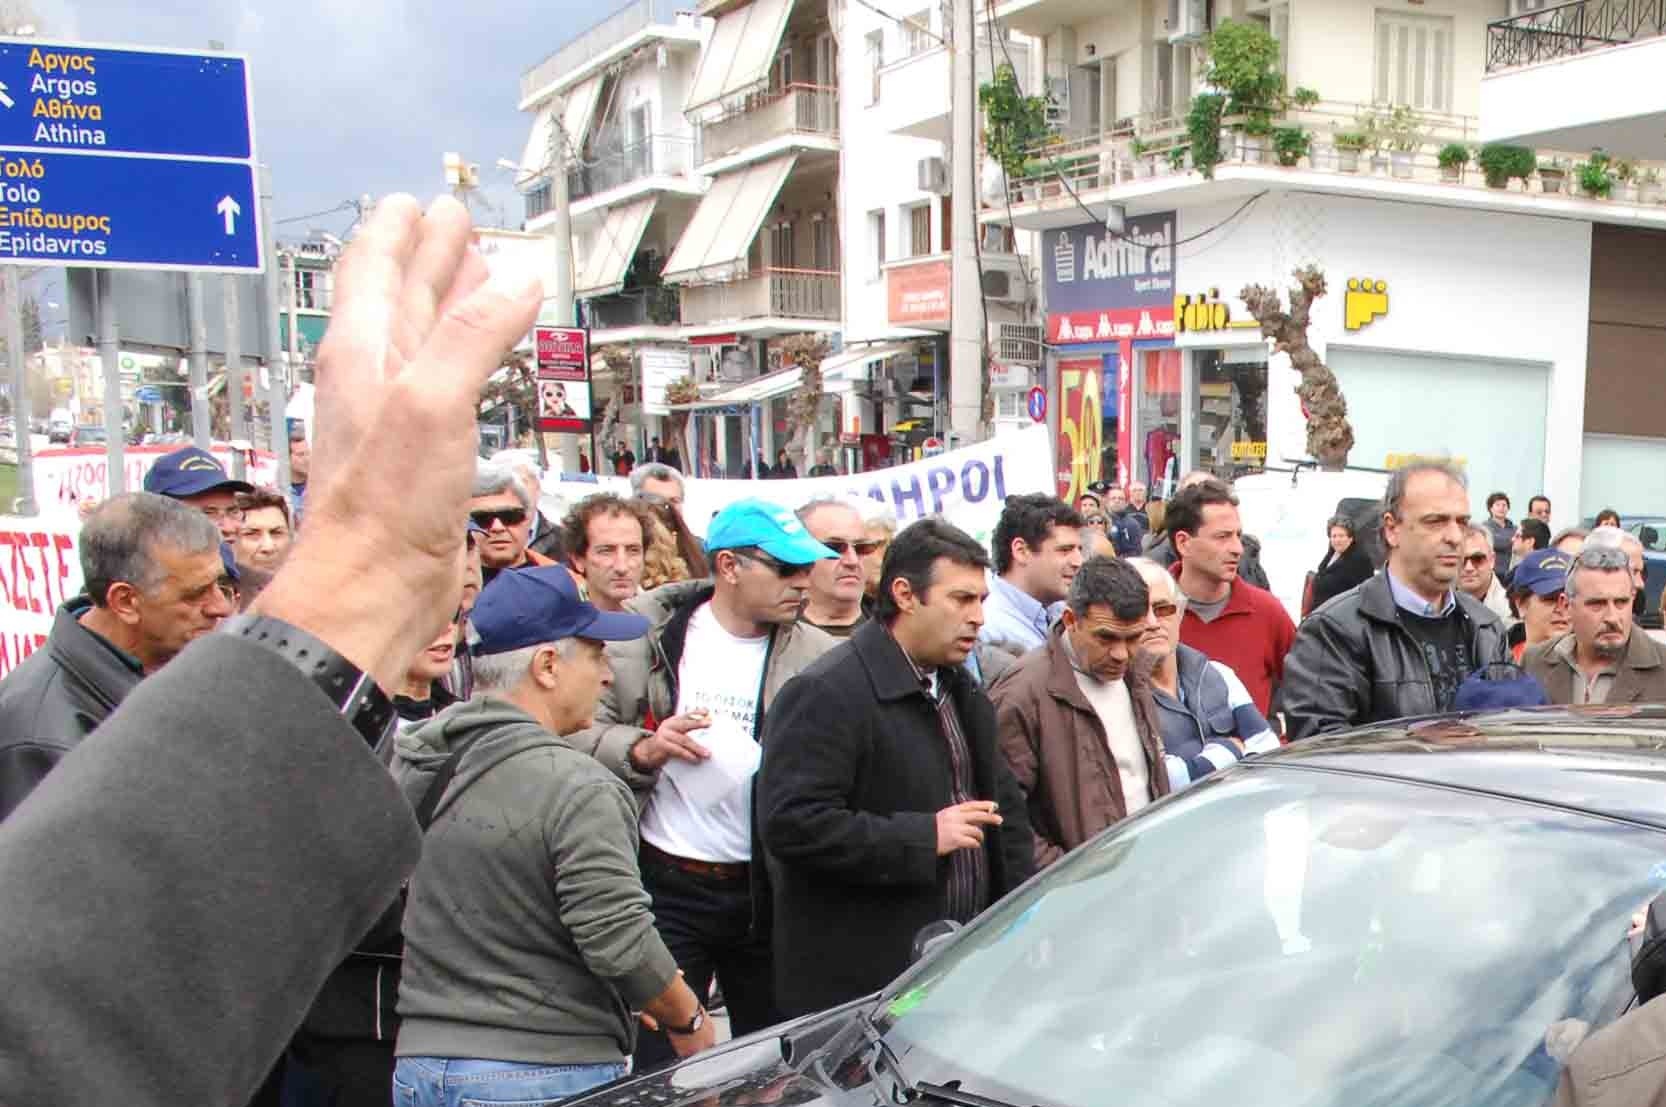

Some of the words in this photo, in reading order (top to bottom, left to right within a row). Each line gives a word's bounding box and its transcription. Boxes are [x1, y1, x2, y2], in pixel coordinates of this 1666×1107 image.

[28, 47, 96, 75] Αργος
[30, 73, 98, 99] Argos
[32, 98, 103, 121] Αθήνα
[34, 122, 106, 145] Athina
[0, 182, 41, 203] Tolo
[0, 207, 111, 235] Επίδαυρος
[0, 231, 107, 256] Epidavros
[1083, 221, 1171, 280] Admiral
[1174, 287, 1230, 332] Fabio
[848, 455, 1007, 521] ΗΡΟΙ
